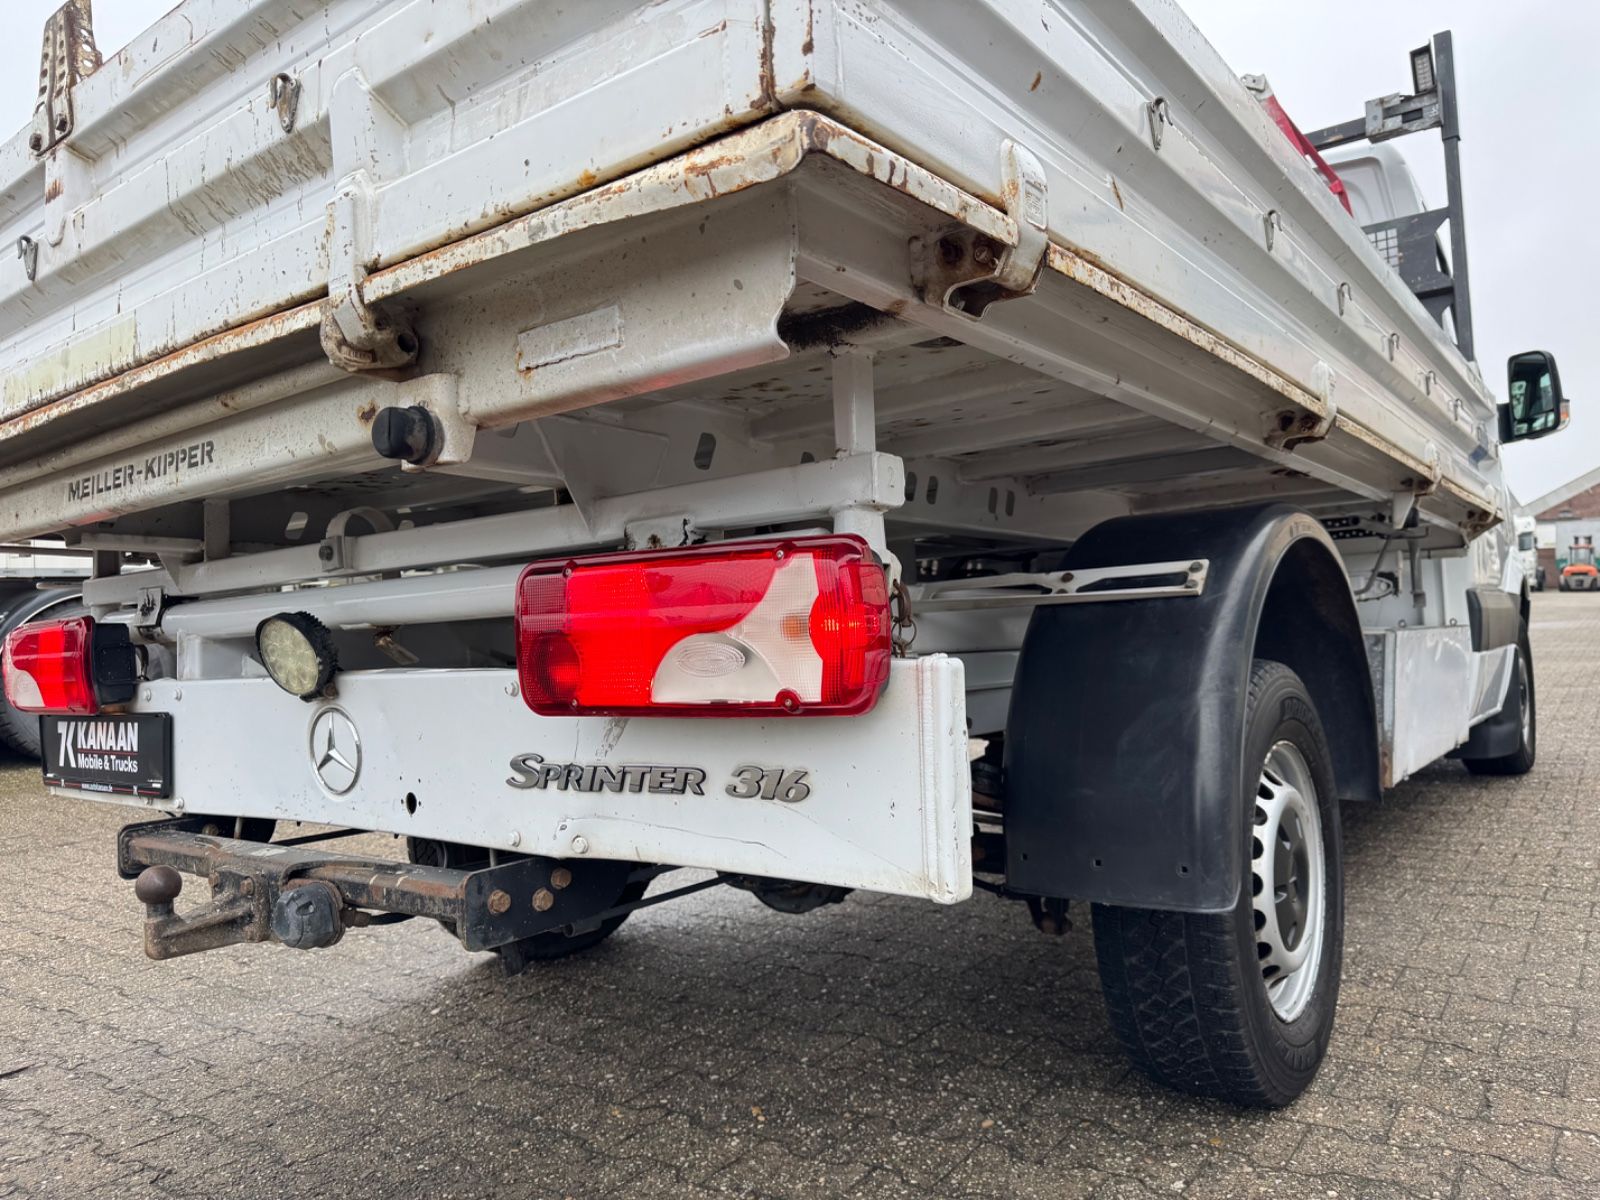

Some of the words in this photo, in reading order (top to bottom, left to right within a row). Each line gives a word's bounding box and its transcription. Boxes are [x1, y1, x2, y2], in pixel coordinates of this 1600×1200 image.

[68, 440, 215, 501] MEILLER-KIPPER
[77, 721, 138, 752] KANAAN
[78, 753, 103, 770] Mobile
[104, 755, 110, 770] &
[111, 755, 138, 773] Trucks
[506, 752, 706, 795] SPRINTER
[725, 765, 811, 802] 316
